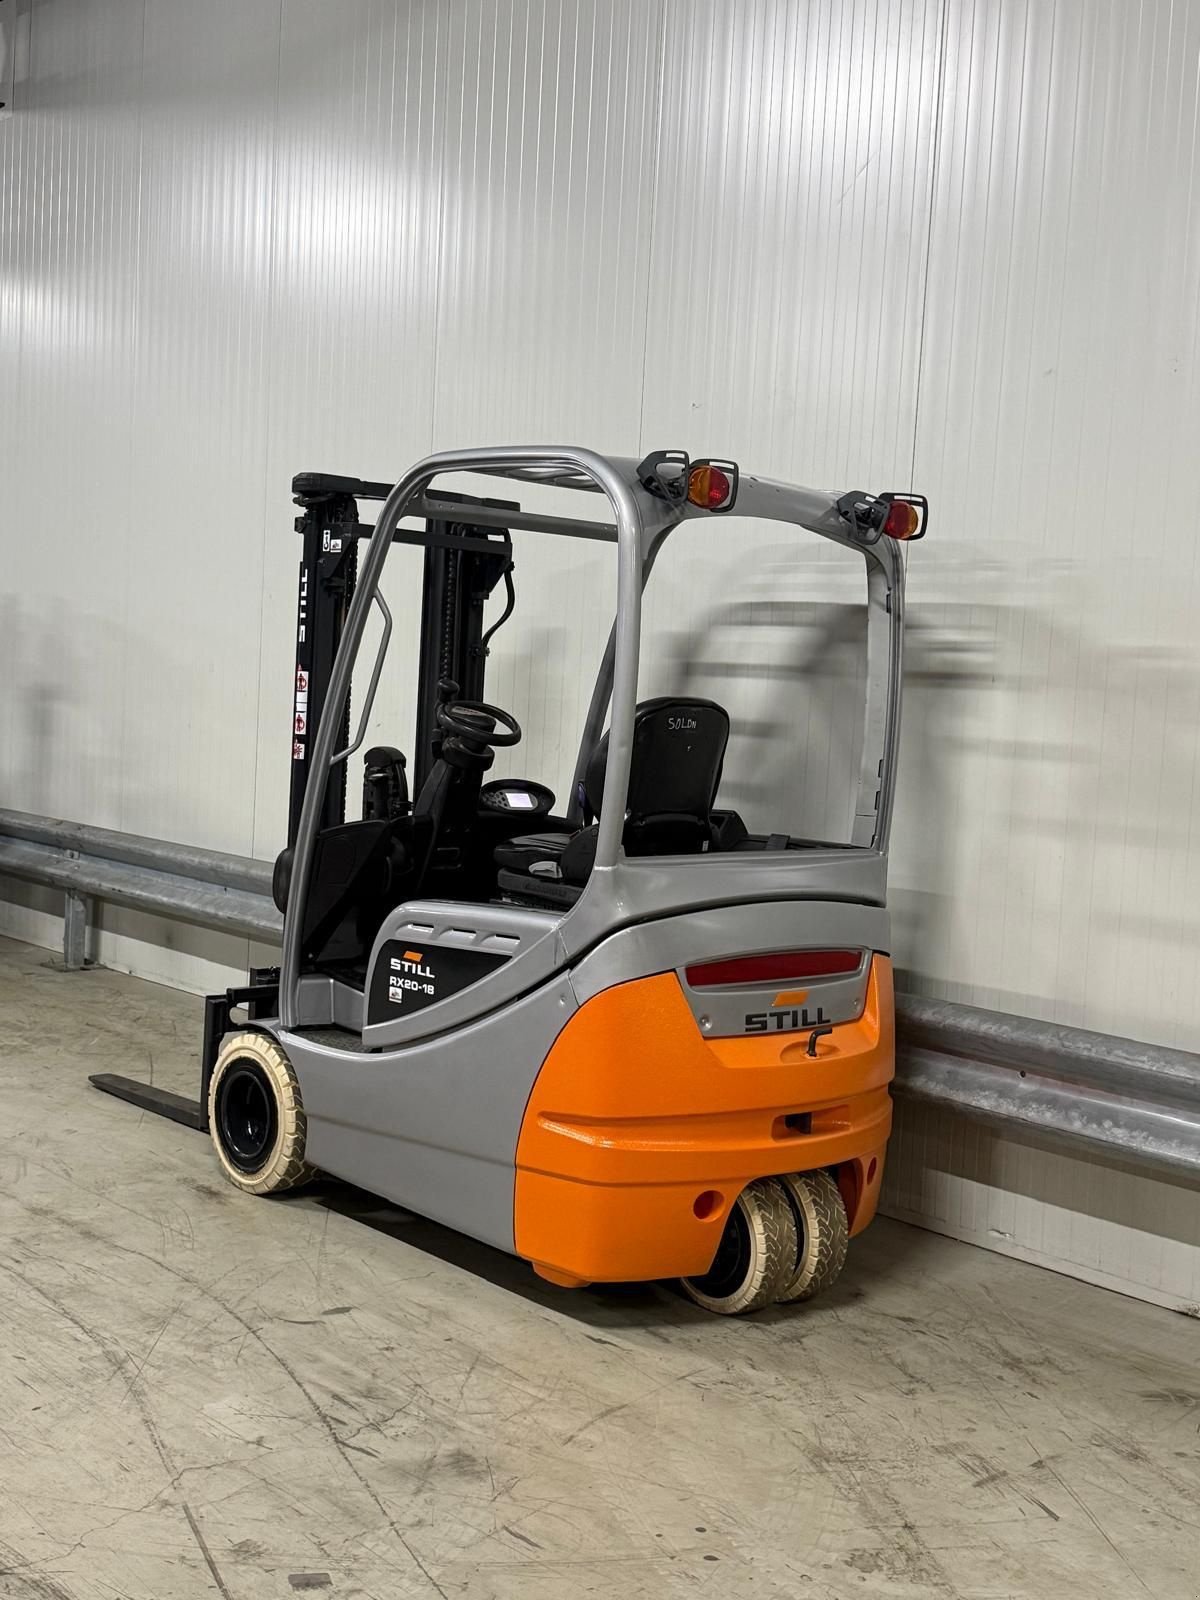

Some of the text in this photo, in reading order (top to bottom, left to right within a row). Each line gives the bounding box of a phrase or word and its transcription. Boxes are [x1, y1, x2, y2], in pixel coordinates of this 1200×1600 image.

[390, 957, 435, 979] STILL
[389, 975, 435, 995] RX20-18
[745, 1007, 831, 1032] STILL
